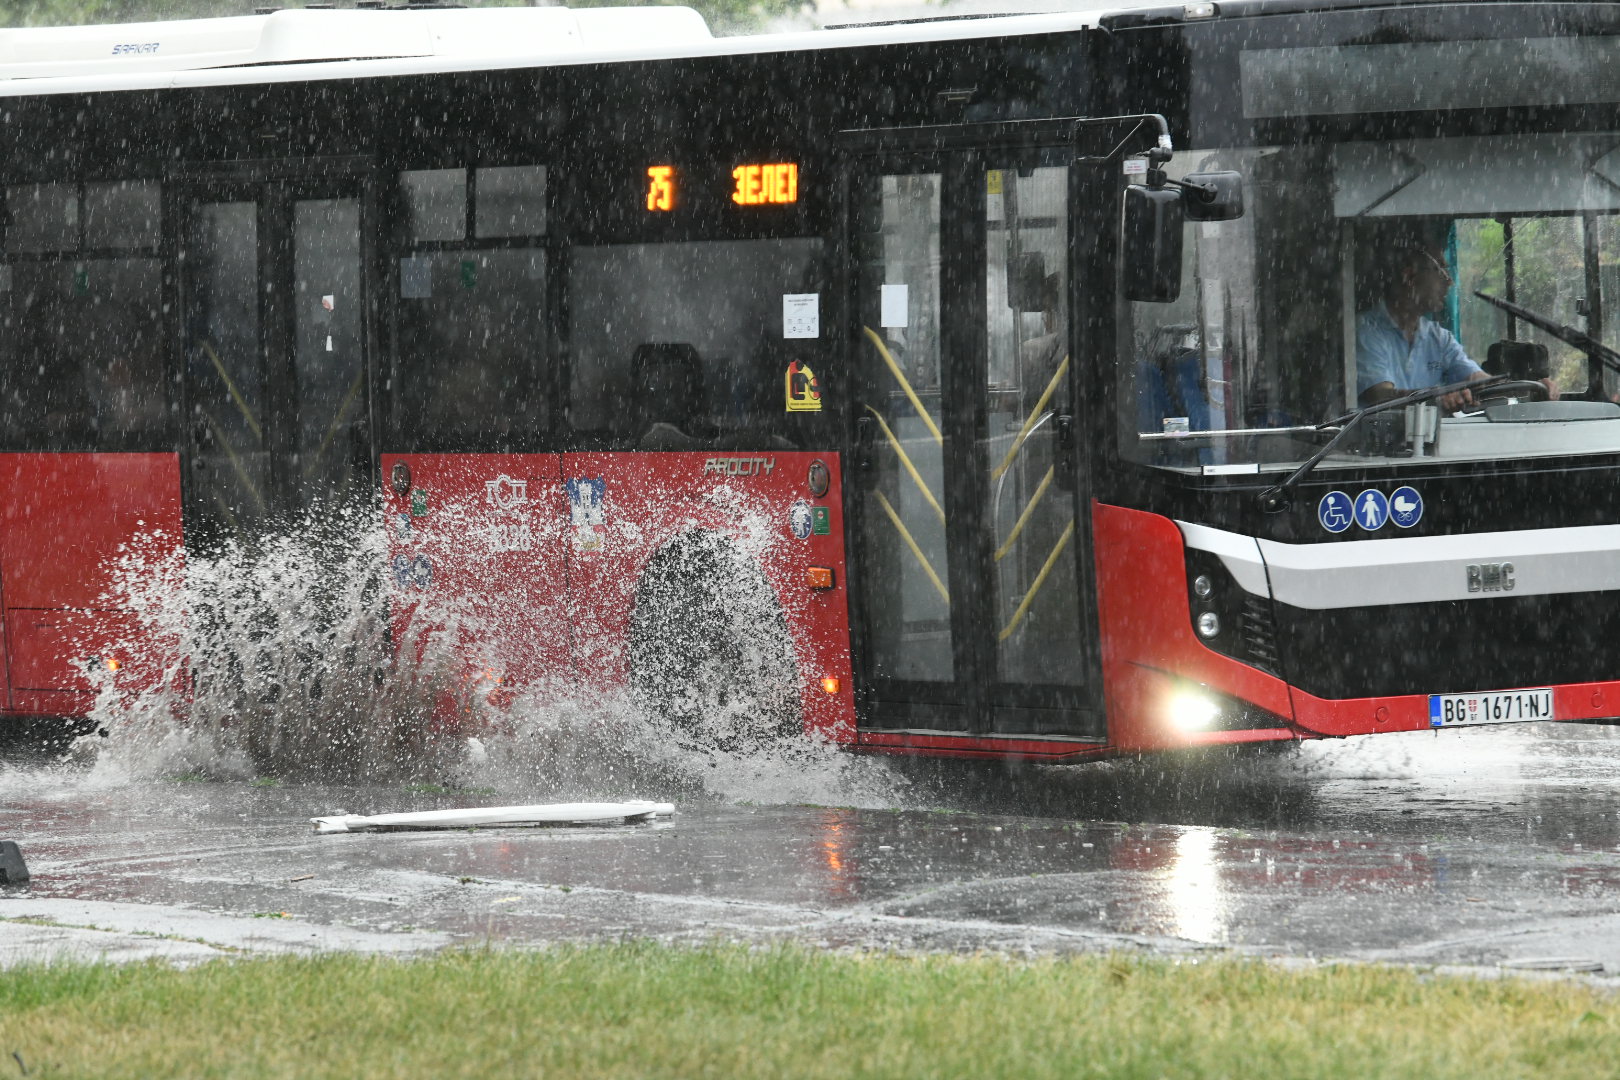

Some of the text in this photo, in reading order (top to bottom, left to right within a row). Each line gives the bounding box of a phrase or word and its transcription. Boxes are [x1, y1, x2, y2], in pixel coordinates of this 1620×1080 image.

[111, 42, 160, 55] SAFKAR
[648, 165, 672, 211] 75
[704, 457, 776, 476] PROCITY
[1466, 562, 1516, 593] BMC
[1444, 698, 1466, 723] BG
